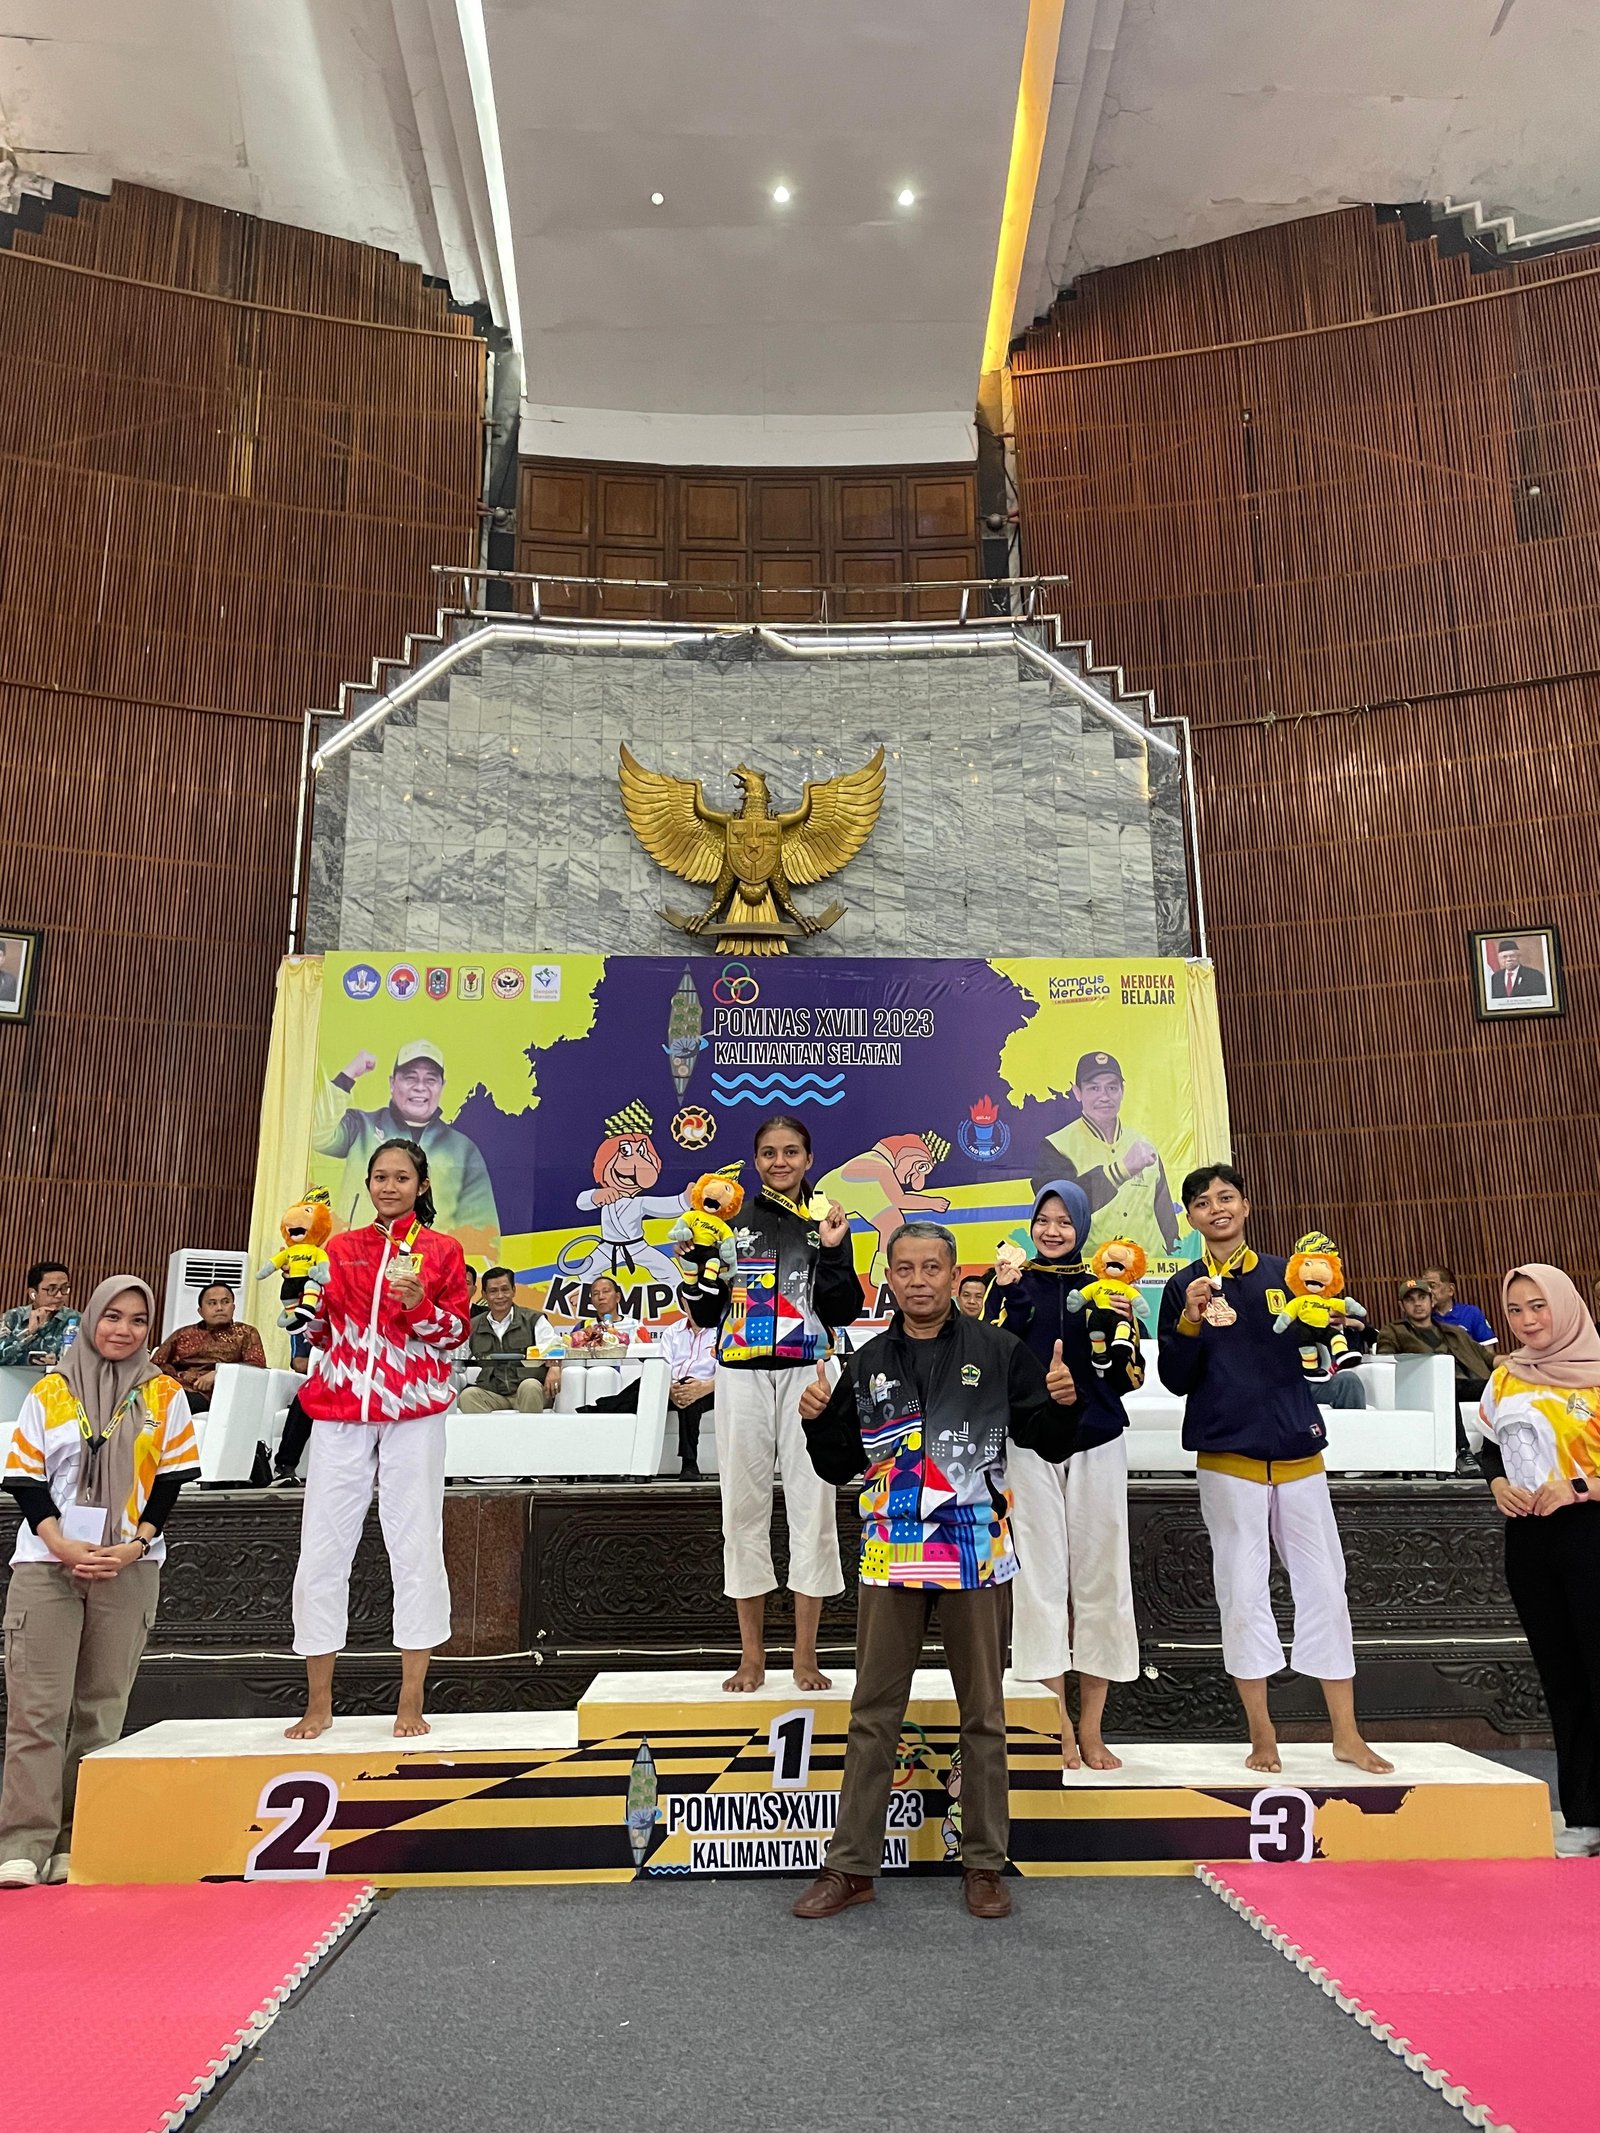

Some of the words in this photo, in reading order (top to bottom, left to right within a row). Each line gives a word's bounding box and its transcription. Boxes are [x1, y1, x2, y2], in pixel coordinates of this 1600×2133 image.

[1049, 975, 1105, 989] Kampus
[1049, 985, 1110, 999] Merdeka
[1121, 975, 1175, 988] MERDEKA
[1121, 990, 1176, 1005] BELAJAR
[714, 1008, 810, 1037] POMNAS
[815, 1009, 868, 1037] XVIII
[873, 1008, 934, 1037] 2023
[715, 1042, 824, 1064] KALIMANTAN
[828, 1043, 901, 1065] SELATAN
[773, 1712, 812, 1785] 1
[247, 1773, 336, 1877] 2
[668, 1794, 780, 1833] POMNAS
[786, 1793, 840, 1830] XVII
[889, 1792, 923, 1829] 23
[1252, 1789, 1313, 1863] 3
[693, 1839, 818, 1869] KALIMANTAN
